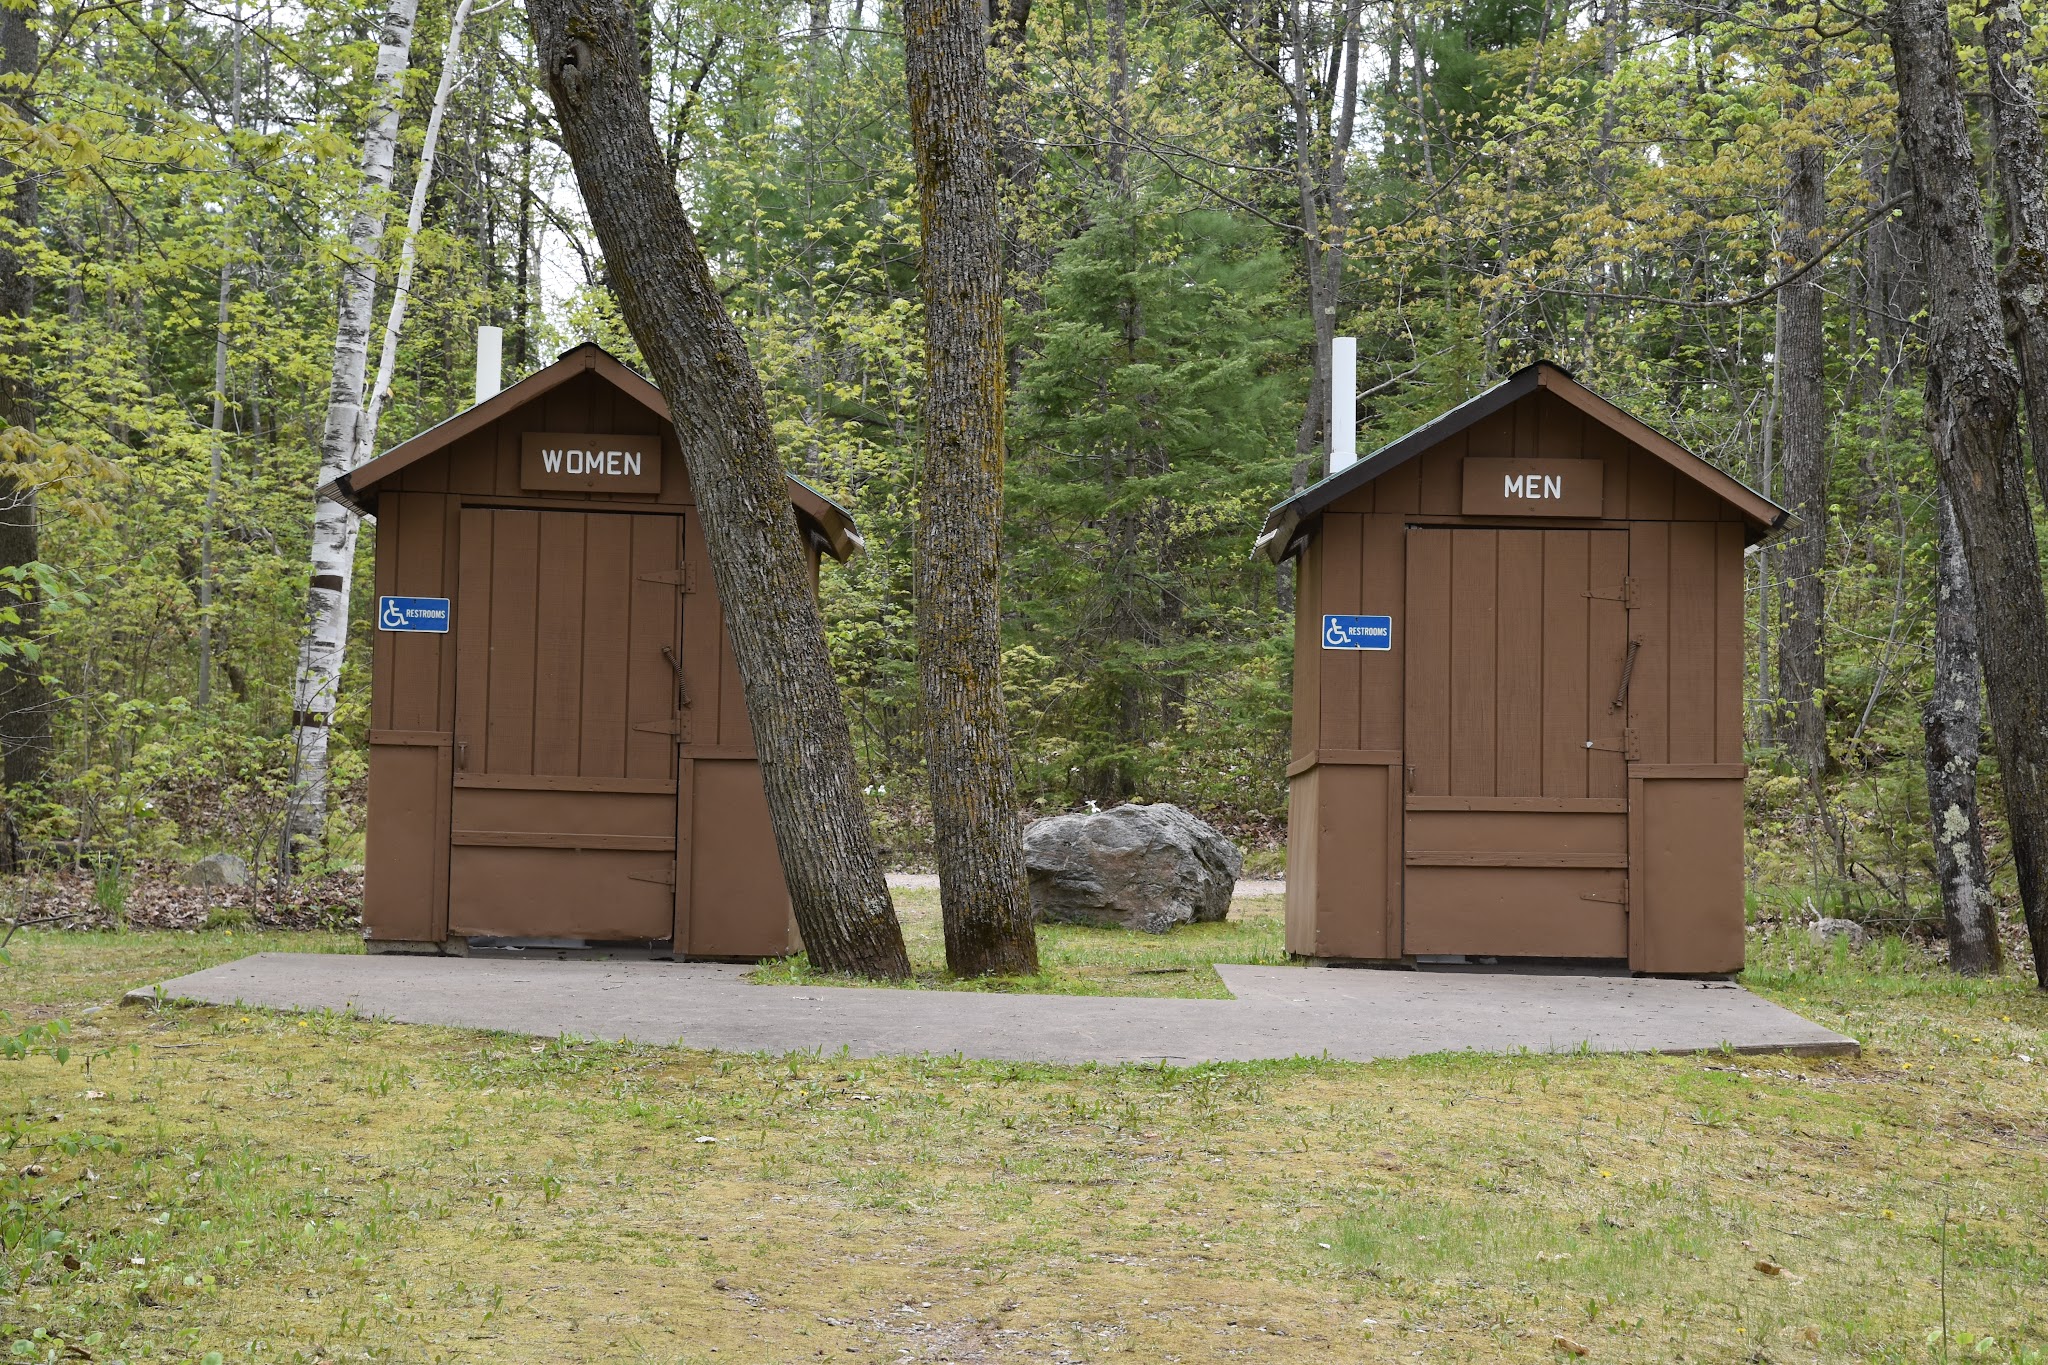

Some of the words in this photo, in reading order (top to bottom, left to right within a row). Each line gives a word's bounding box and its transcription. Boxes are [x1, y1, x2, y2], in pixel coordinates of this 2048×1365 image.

[541, 449, 641, 476] WOMEN
[1504, 474, 1562, 499] MEN
[406, 608, 446, 619] RESTROOMS
[1348, 626, 1388, 637] RESTROOMS
